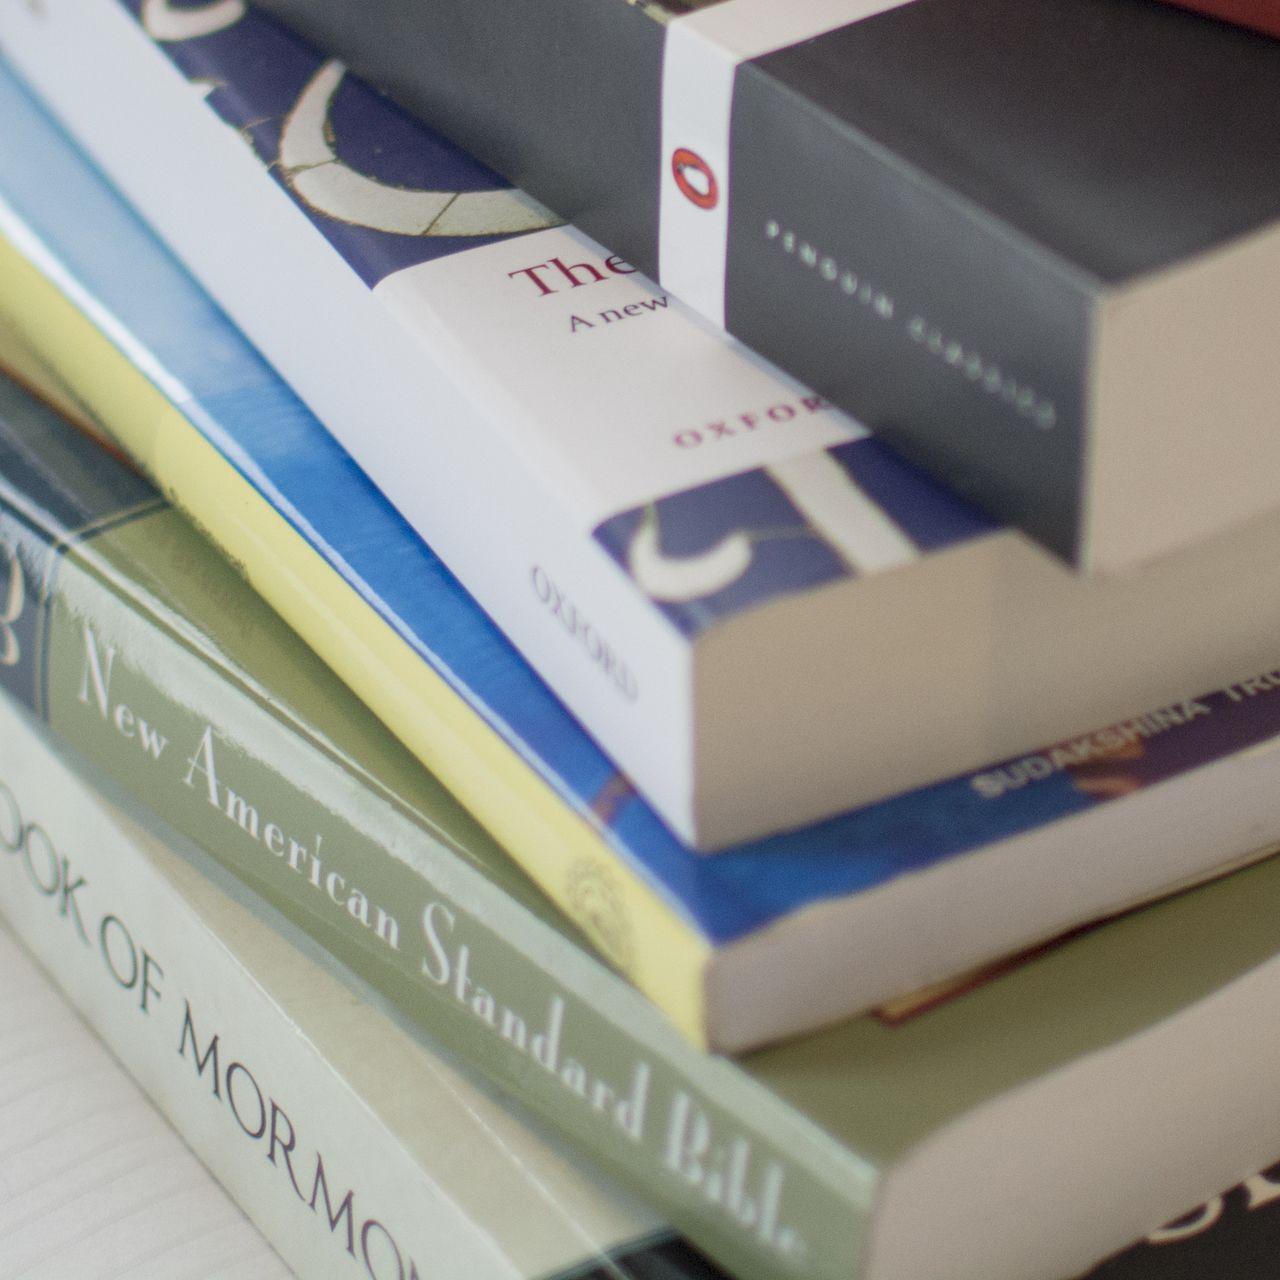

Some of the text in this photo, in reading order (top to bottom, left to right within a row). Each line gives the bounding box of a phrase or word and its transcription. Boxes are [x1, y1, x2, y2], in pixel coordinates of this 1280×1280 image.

[507, 253, 639, 298] The
[569, 294, 671, 334] A new
[969, 695, 1212, 801] SUDAKSHINA
[70, 620, 168, 761] New
[182, 723, 404, 953] American
[421, 901, 652, 1144] Standard
[99, 913, 164, 1016] OF
[176, 996, 421, 1280] MORMO
